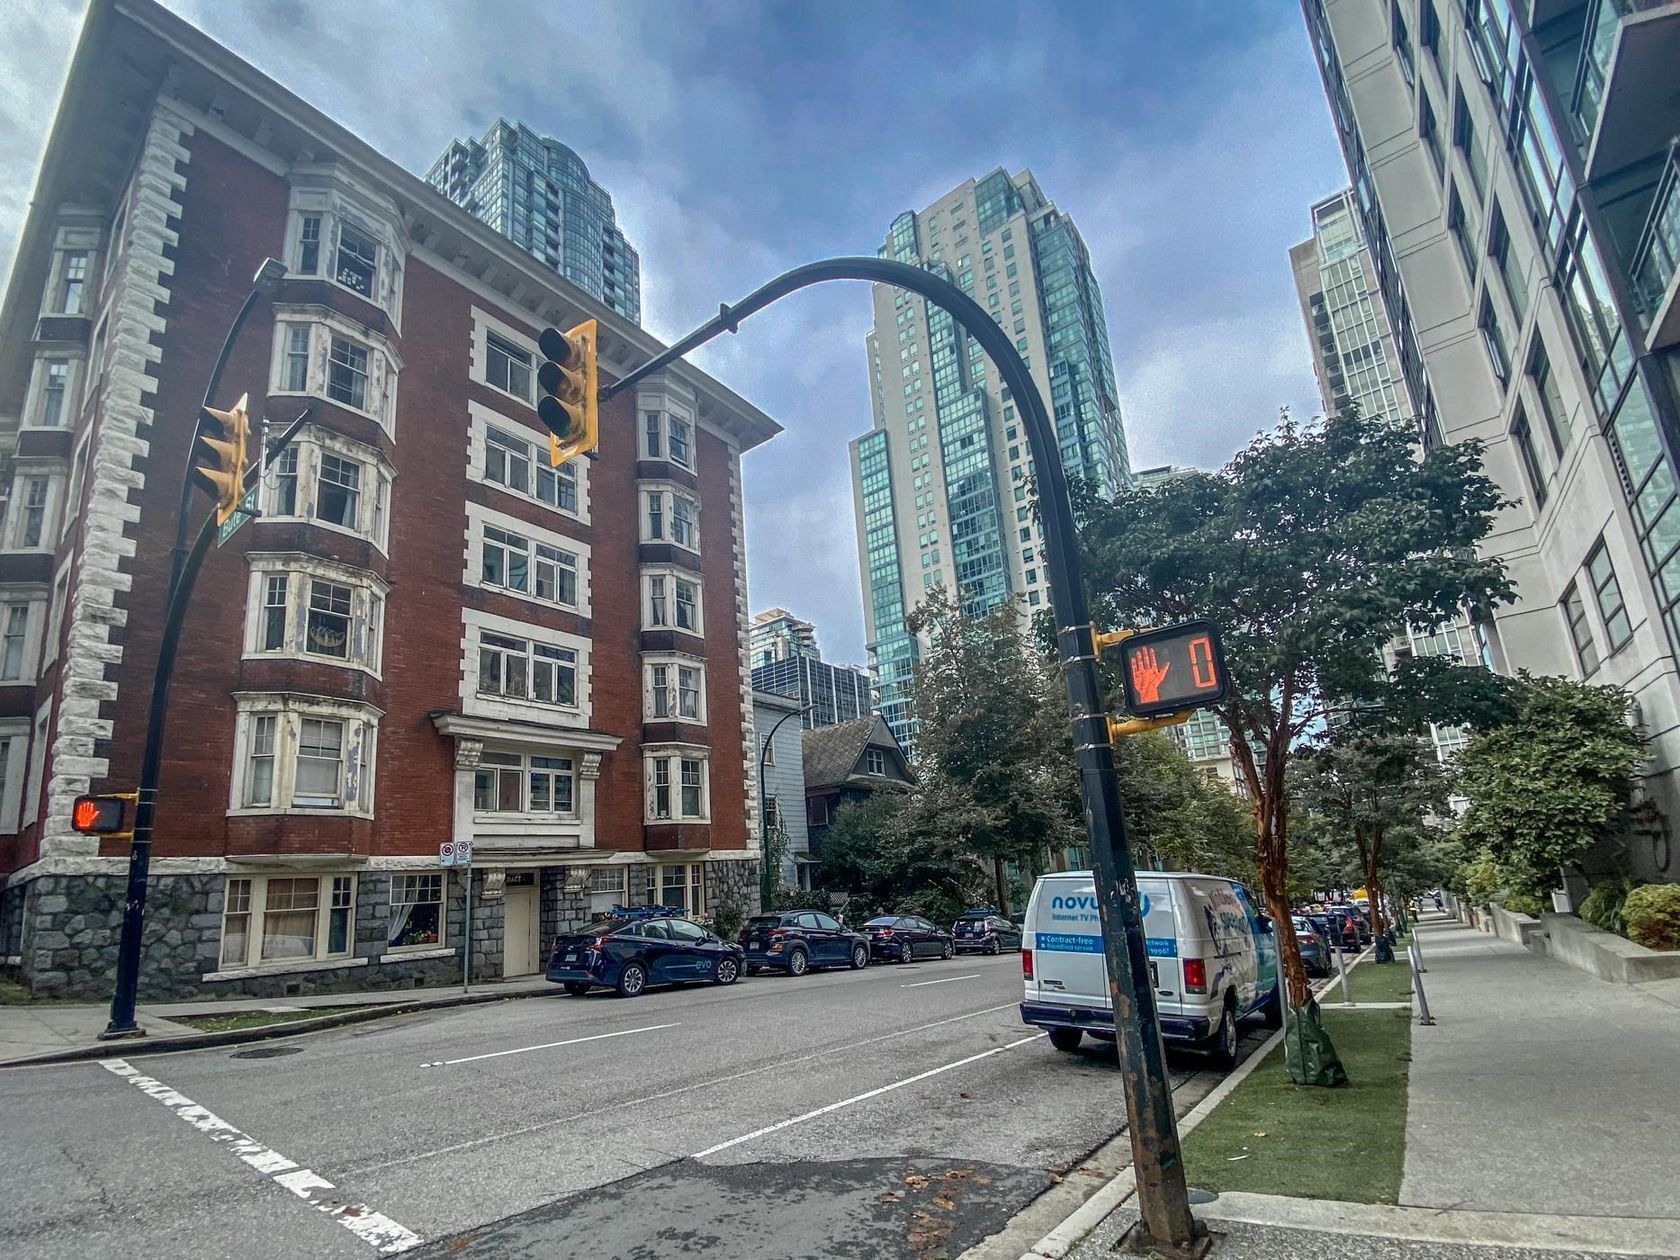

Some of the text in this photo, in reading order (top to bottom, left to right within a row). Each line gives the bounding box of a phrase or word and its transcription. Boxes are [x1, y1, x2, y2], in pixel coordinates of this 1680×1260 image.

[223, 493, 255, 538] Bute St
[1188, 636, 1217, 688] 0
[1052, 896, 1099, 910] novu
[1052, 913, 1099, 922] Internet TV Ph
[1047, 935, 1094, 945] Contract-free
[696, 960, 712, 970] evo
